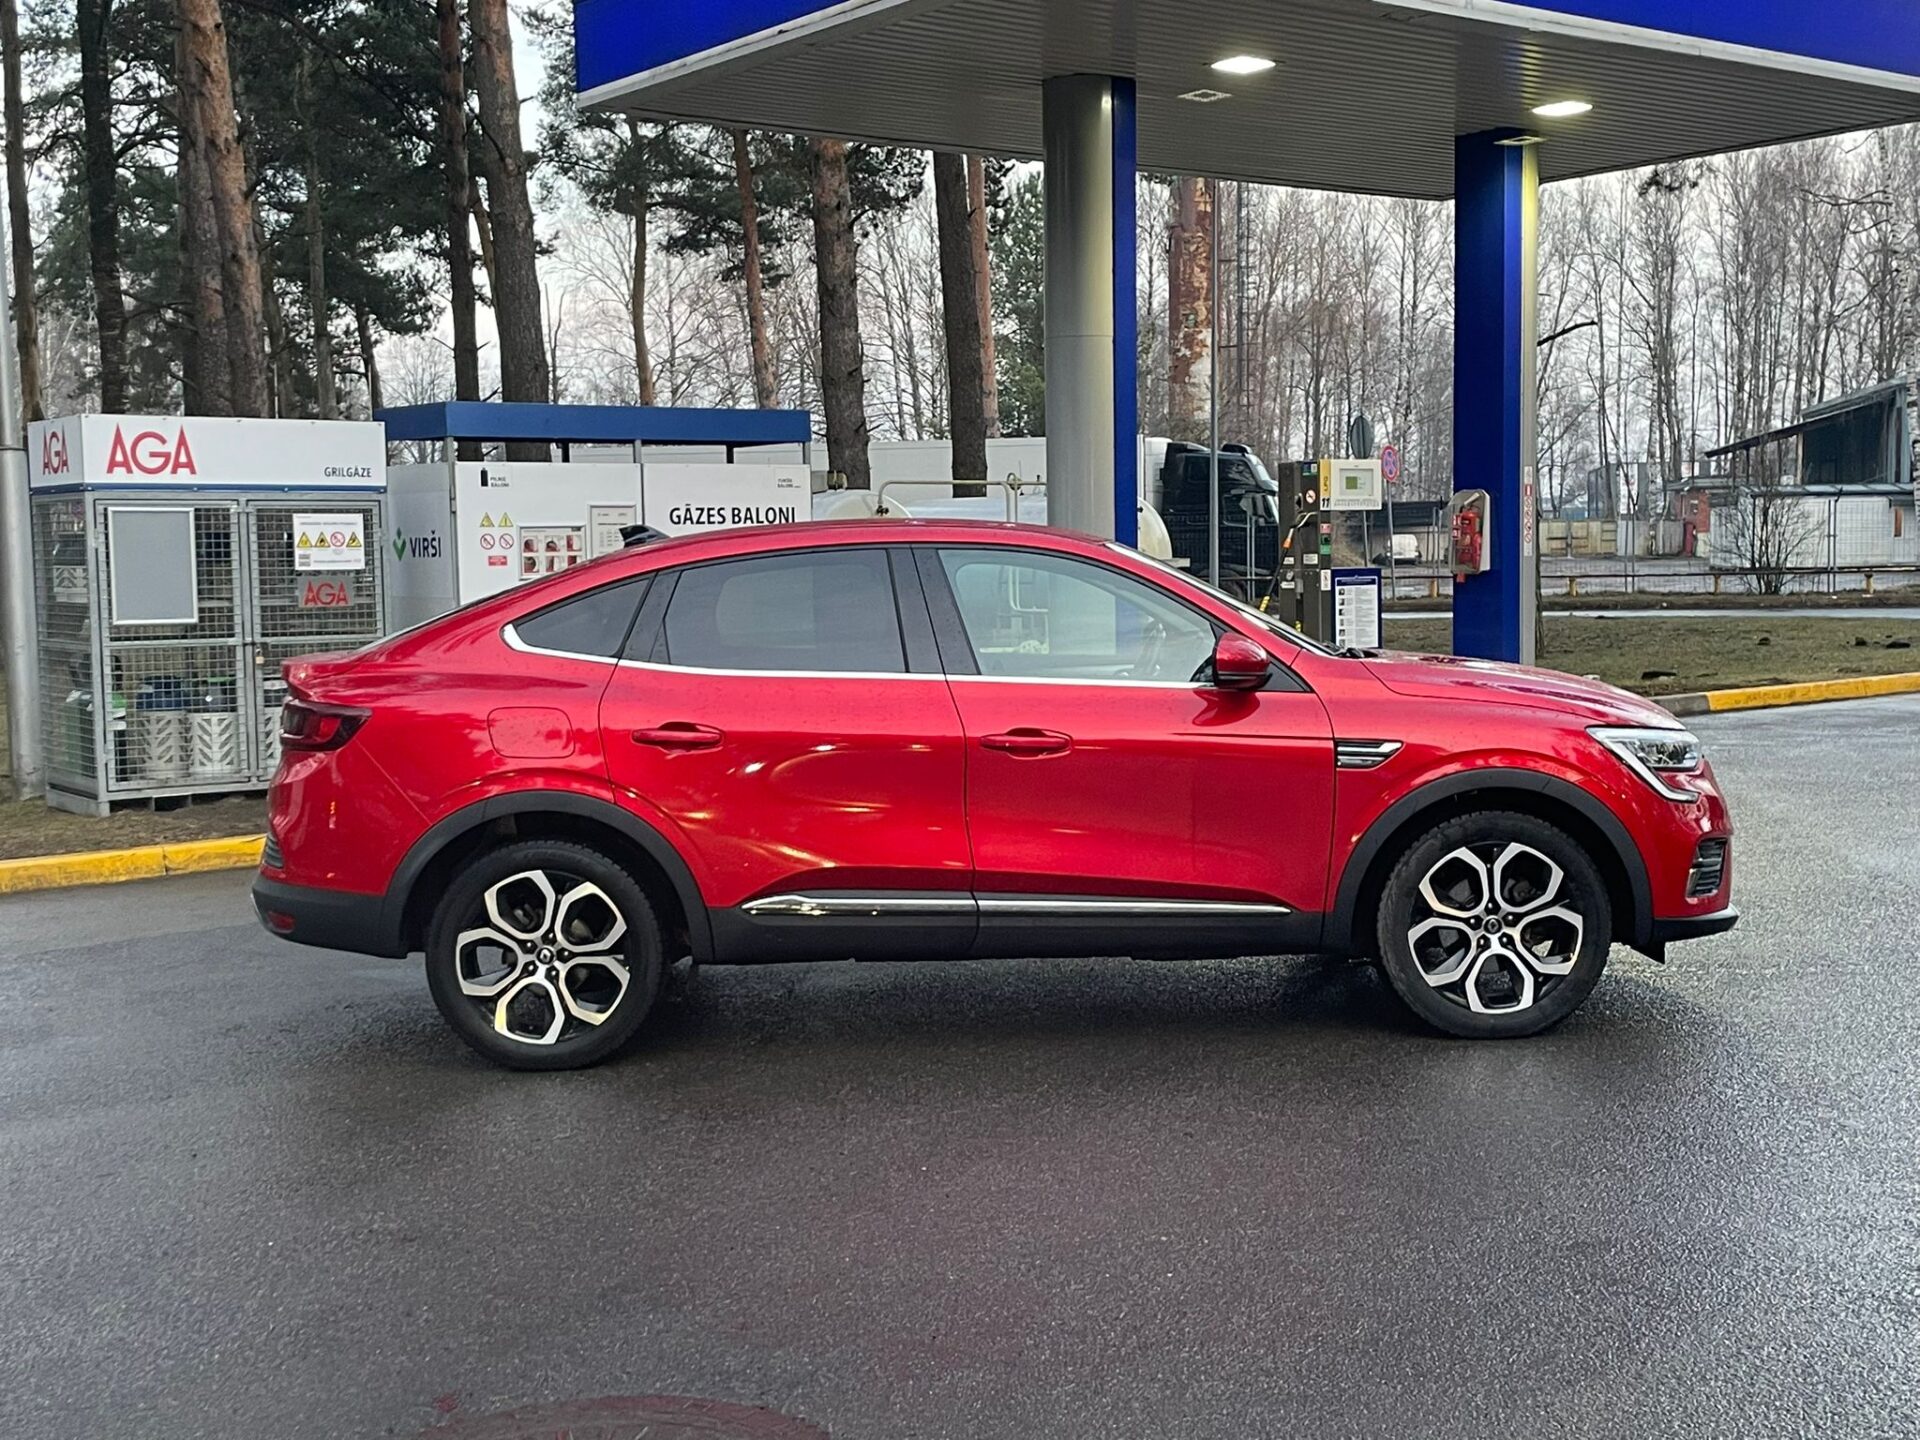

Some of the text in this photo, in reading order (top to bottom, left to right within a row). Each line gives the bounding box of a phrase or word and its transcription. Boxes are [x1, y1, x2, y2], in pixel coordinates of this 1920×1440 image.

[42, 425, 69, 475] AGA
[106, 423, 197, 475] AGA
[324, 466, 372, 478] GRILGĀZE
[669, 503, 795, 525] GĀZES BALONI
[1321, 498, 1330, 508] 11
[409, 530, 442, 558] VIRŠI
[304, 580, 348, 605] AGA
